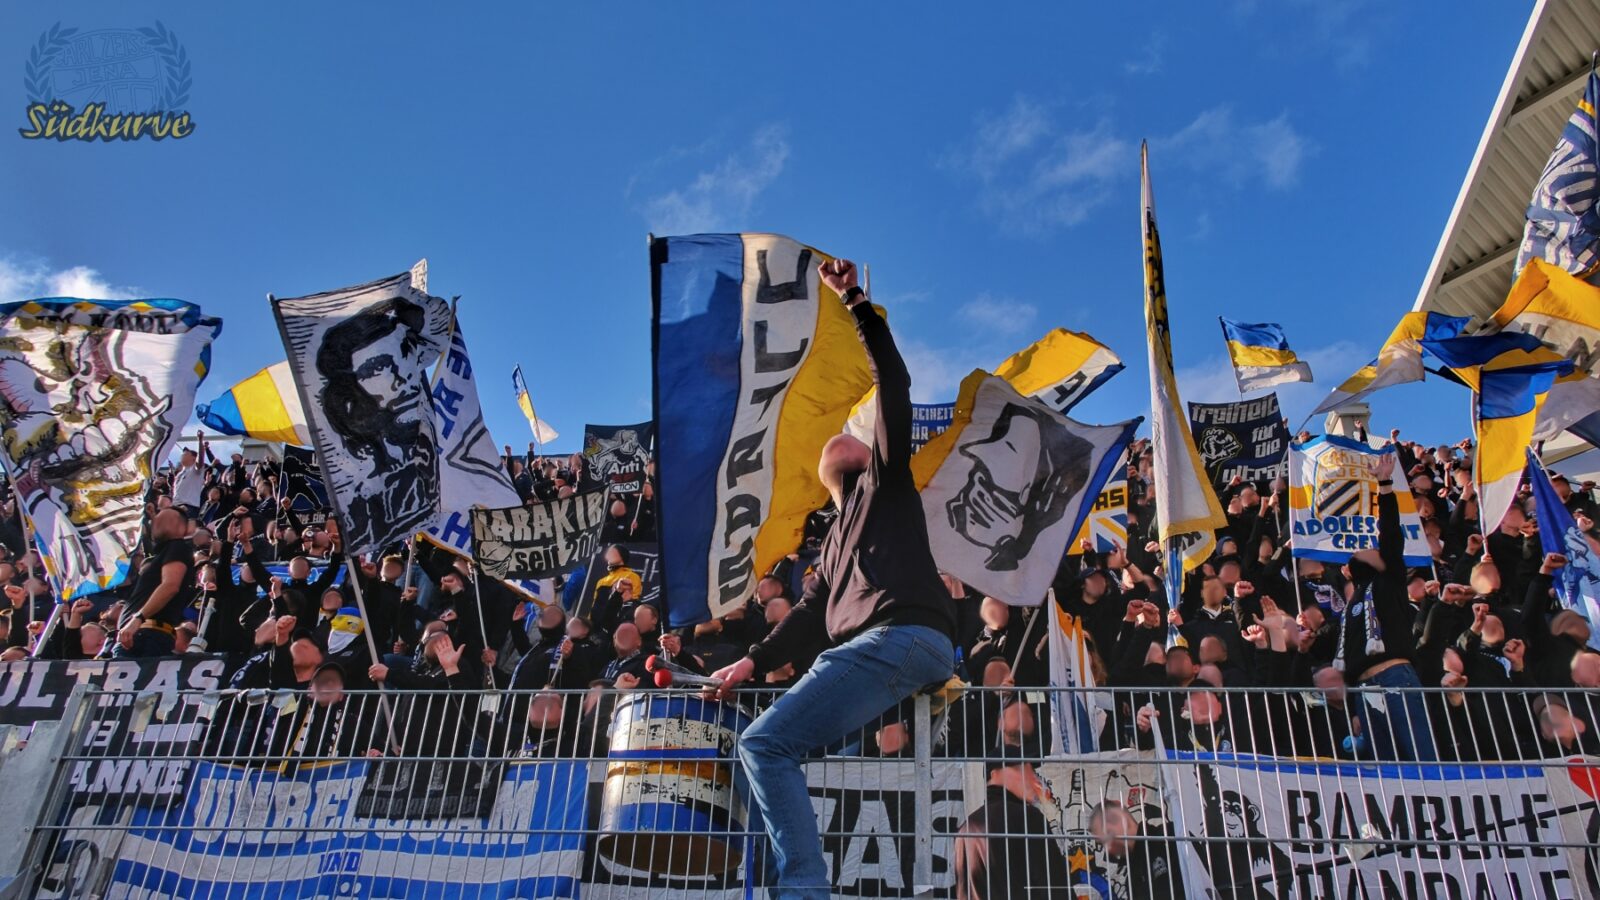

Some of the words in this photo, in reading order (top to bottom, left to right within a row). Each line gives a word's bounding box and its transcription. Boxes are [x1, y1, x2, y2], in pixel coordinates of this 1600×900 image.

[912, 407, 954, 420] REIHEIT
[1252, 423, 1278, 443] für
[608, 458, 640, 475] Anti
[0, 659, 225, 708] ULTRAS
[1287, 789, 1559, 861] BAMBULE
